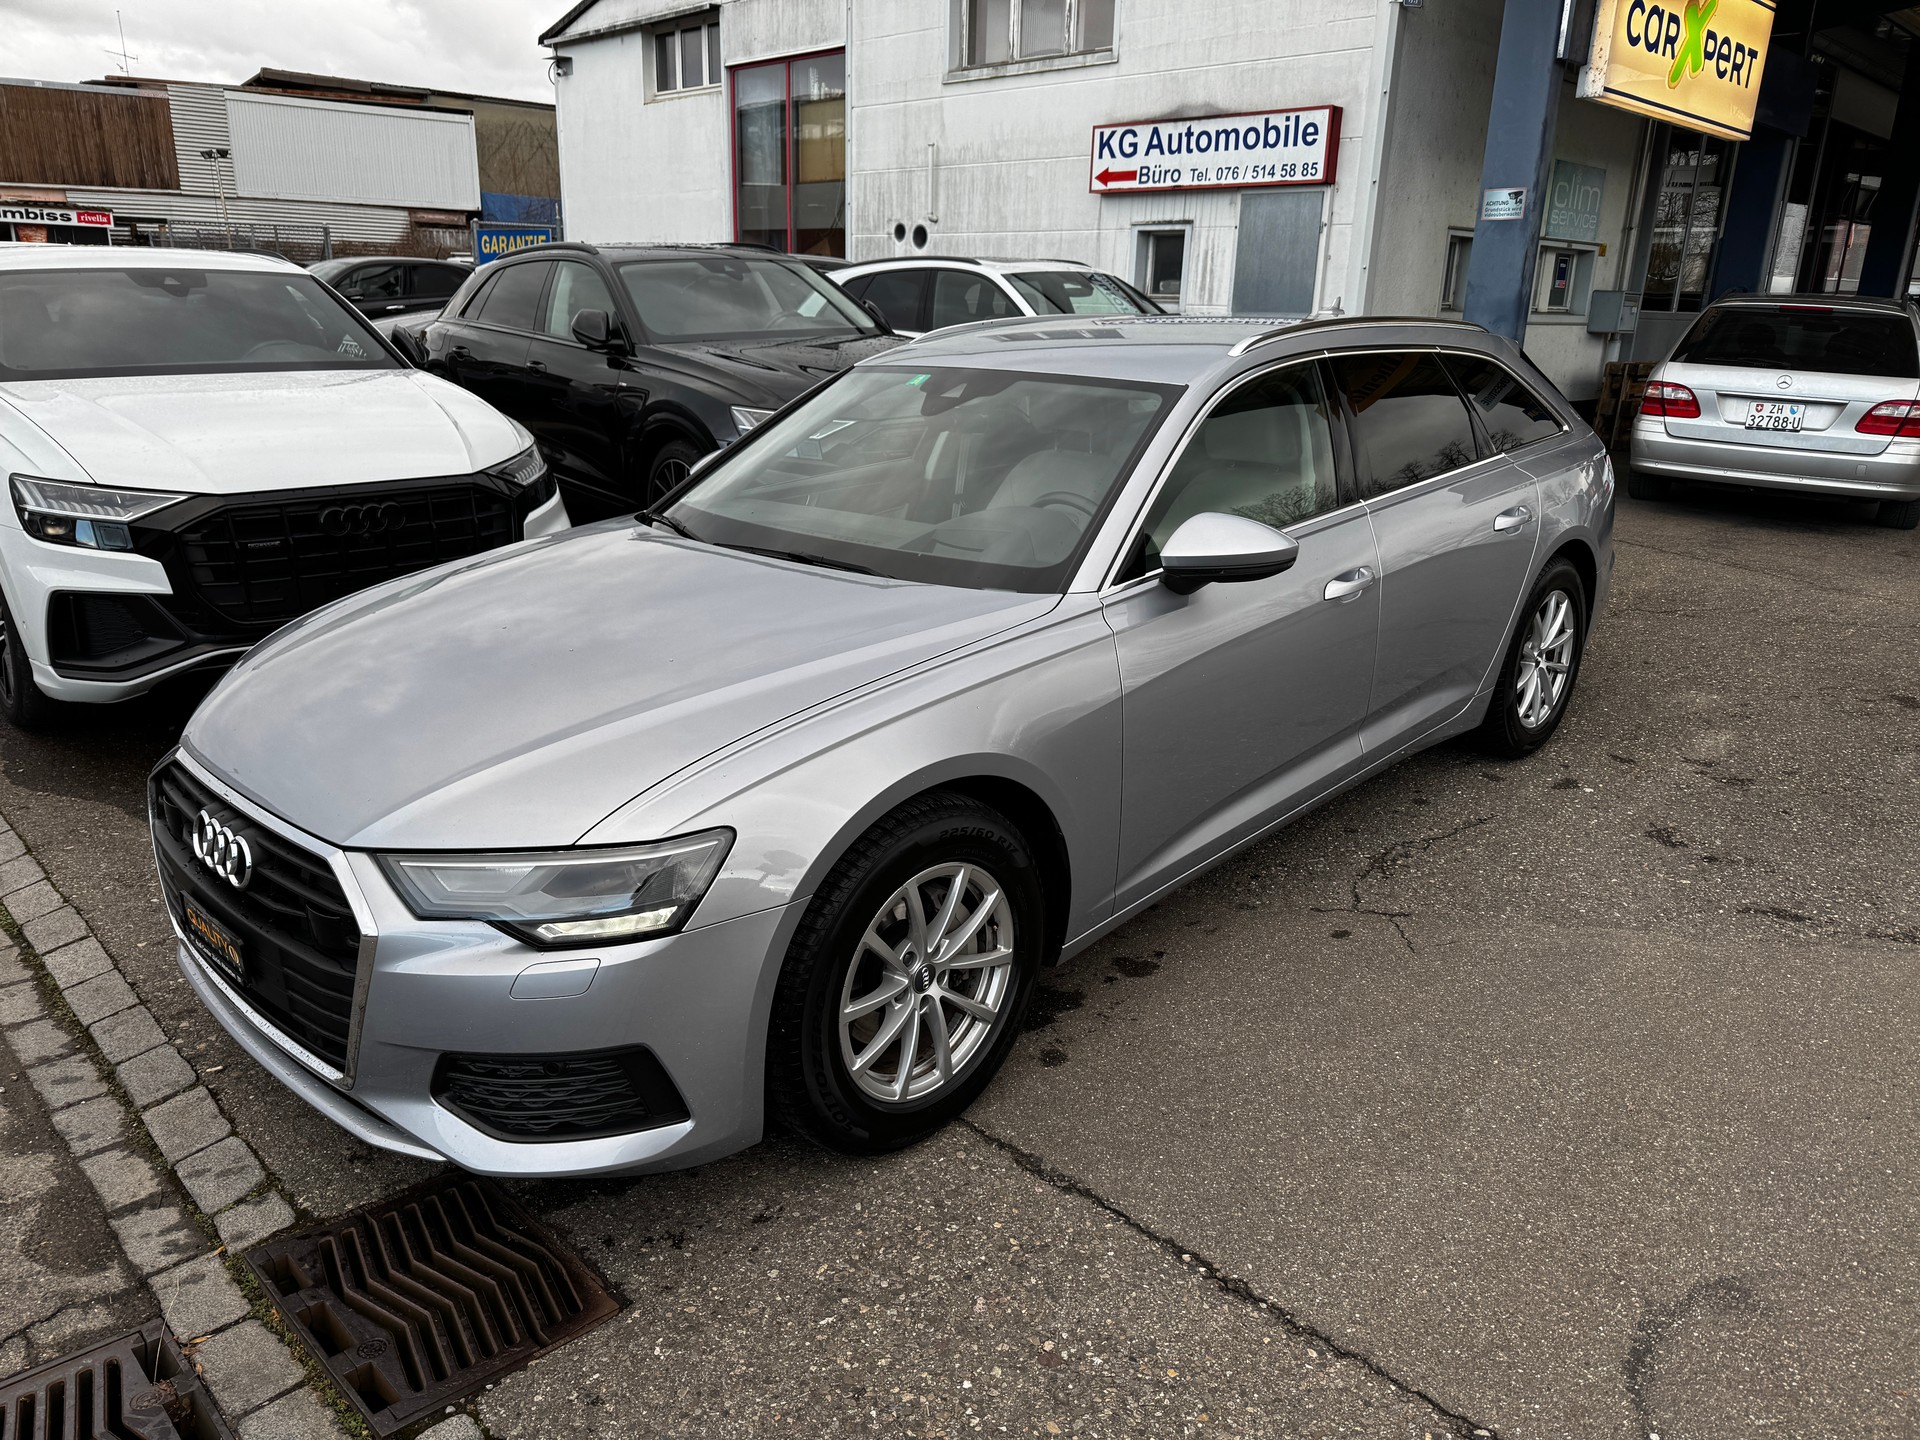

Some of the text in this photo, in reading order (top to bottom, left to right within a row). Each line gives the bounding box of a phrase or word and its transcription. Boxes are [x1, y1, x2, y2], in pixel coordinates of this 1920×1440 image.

[1098, 114, 1320, 160] KG Automobile
[1138, 161, 1319, 185] Büro Tel. 076 / 514 58 85
[1554, 172, 1601, 213] clim
[0, 208, 72, 223] mbiss
[80, 213, 107, 223] rivella
[1550, 209, 1598, 229] service
[1769, 404, 1784, 415] ZH
[187, 907, 230, 955] QUALITY
